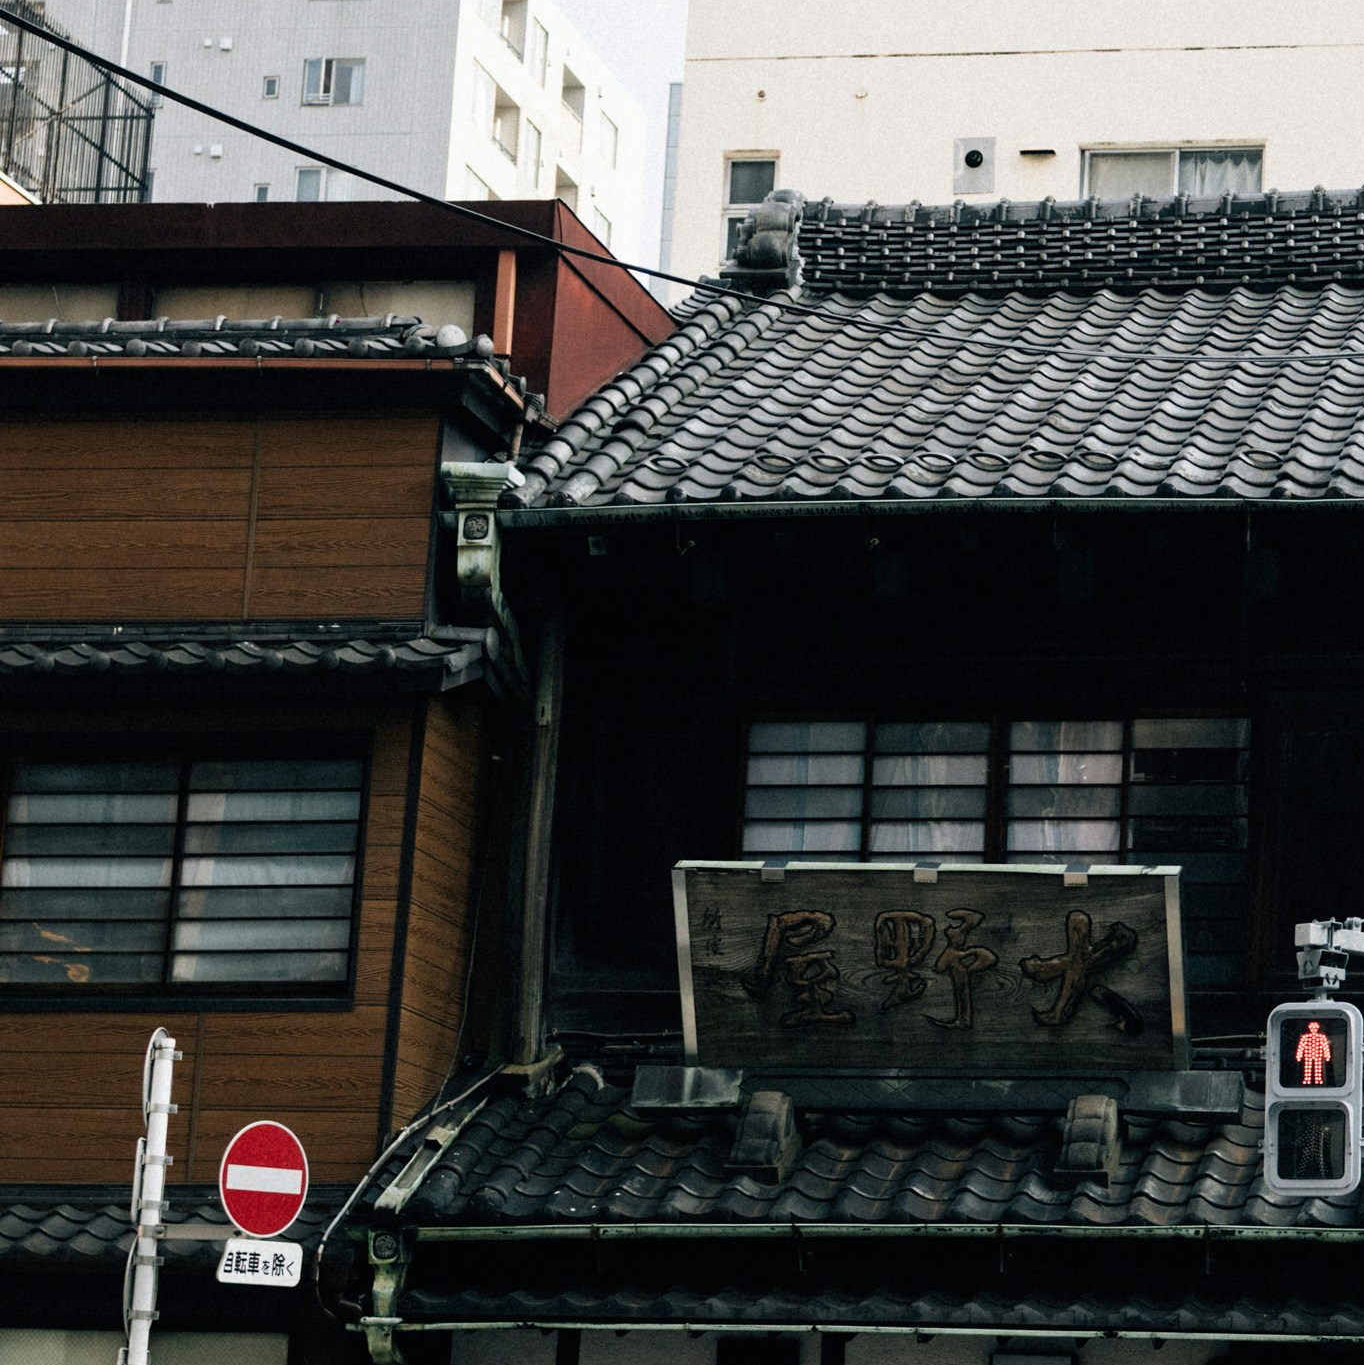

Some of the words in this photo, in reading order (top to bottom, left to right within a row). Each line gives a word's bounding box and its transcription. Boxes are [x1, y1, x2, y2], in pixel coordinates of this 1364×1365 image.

[223, 1251, 294, 1276] 自転車を除く
